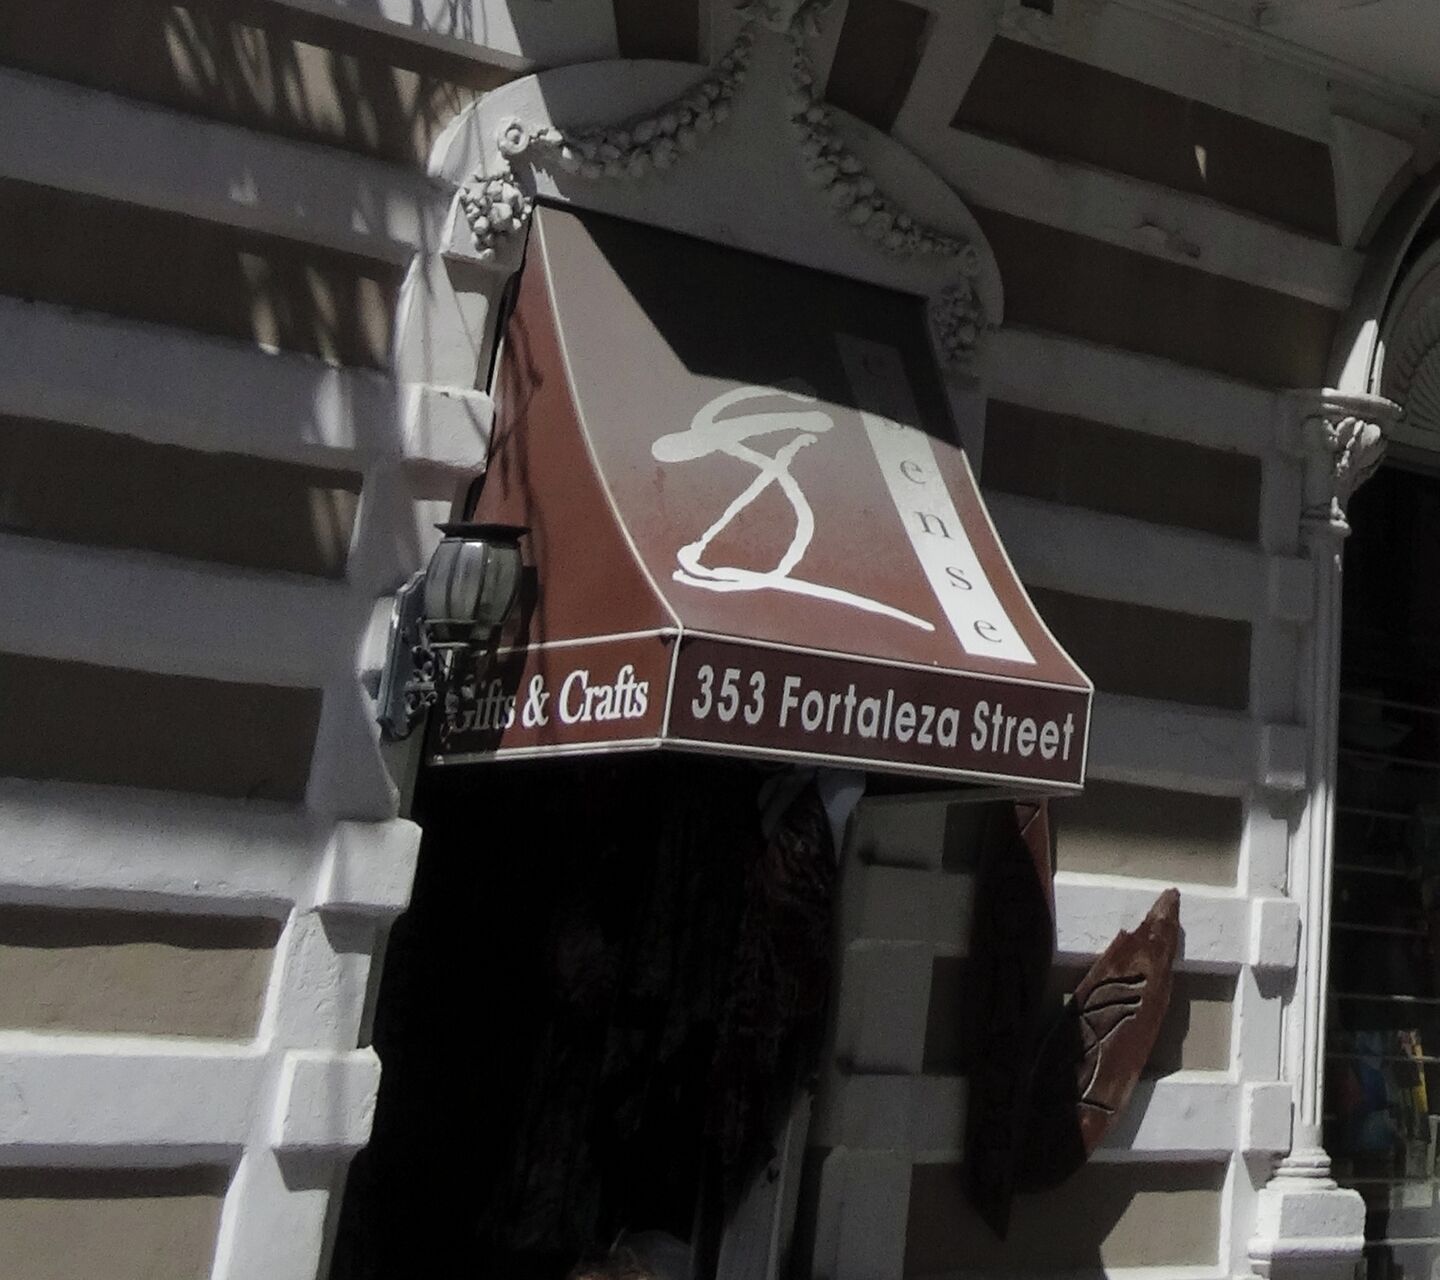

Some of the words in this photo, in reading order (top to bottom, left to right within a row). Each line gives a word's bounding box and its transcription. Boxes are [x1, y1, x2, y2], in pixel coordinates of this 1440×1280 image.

[522, 674, 549, 728] &
[559, 664, 649, 724] Crafts
[692, 664, 766, 725] 353
[779, 675, 960, 748] Fortaleza
[970, 700, 1075, 761] Street
